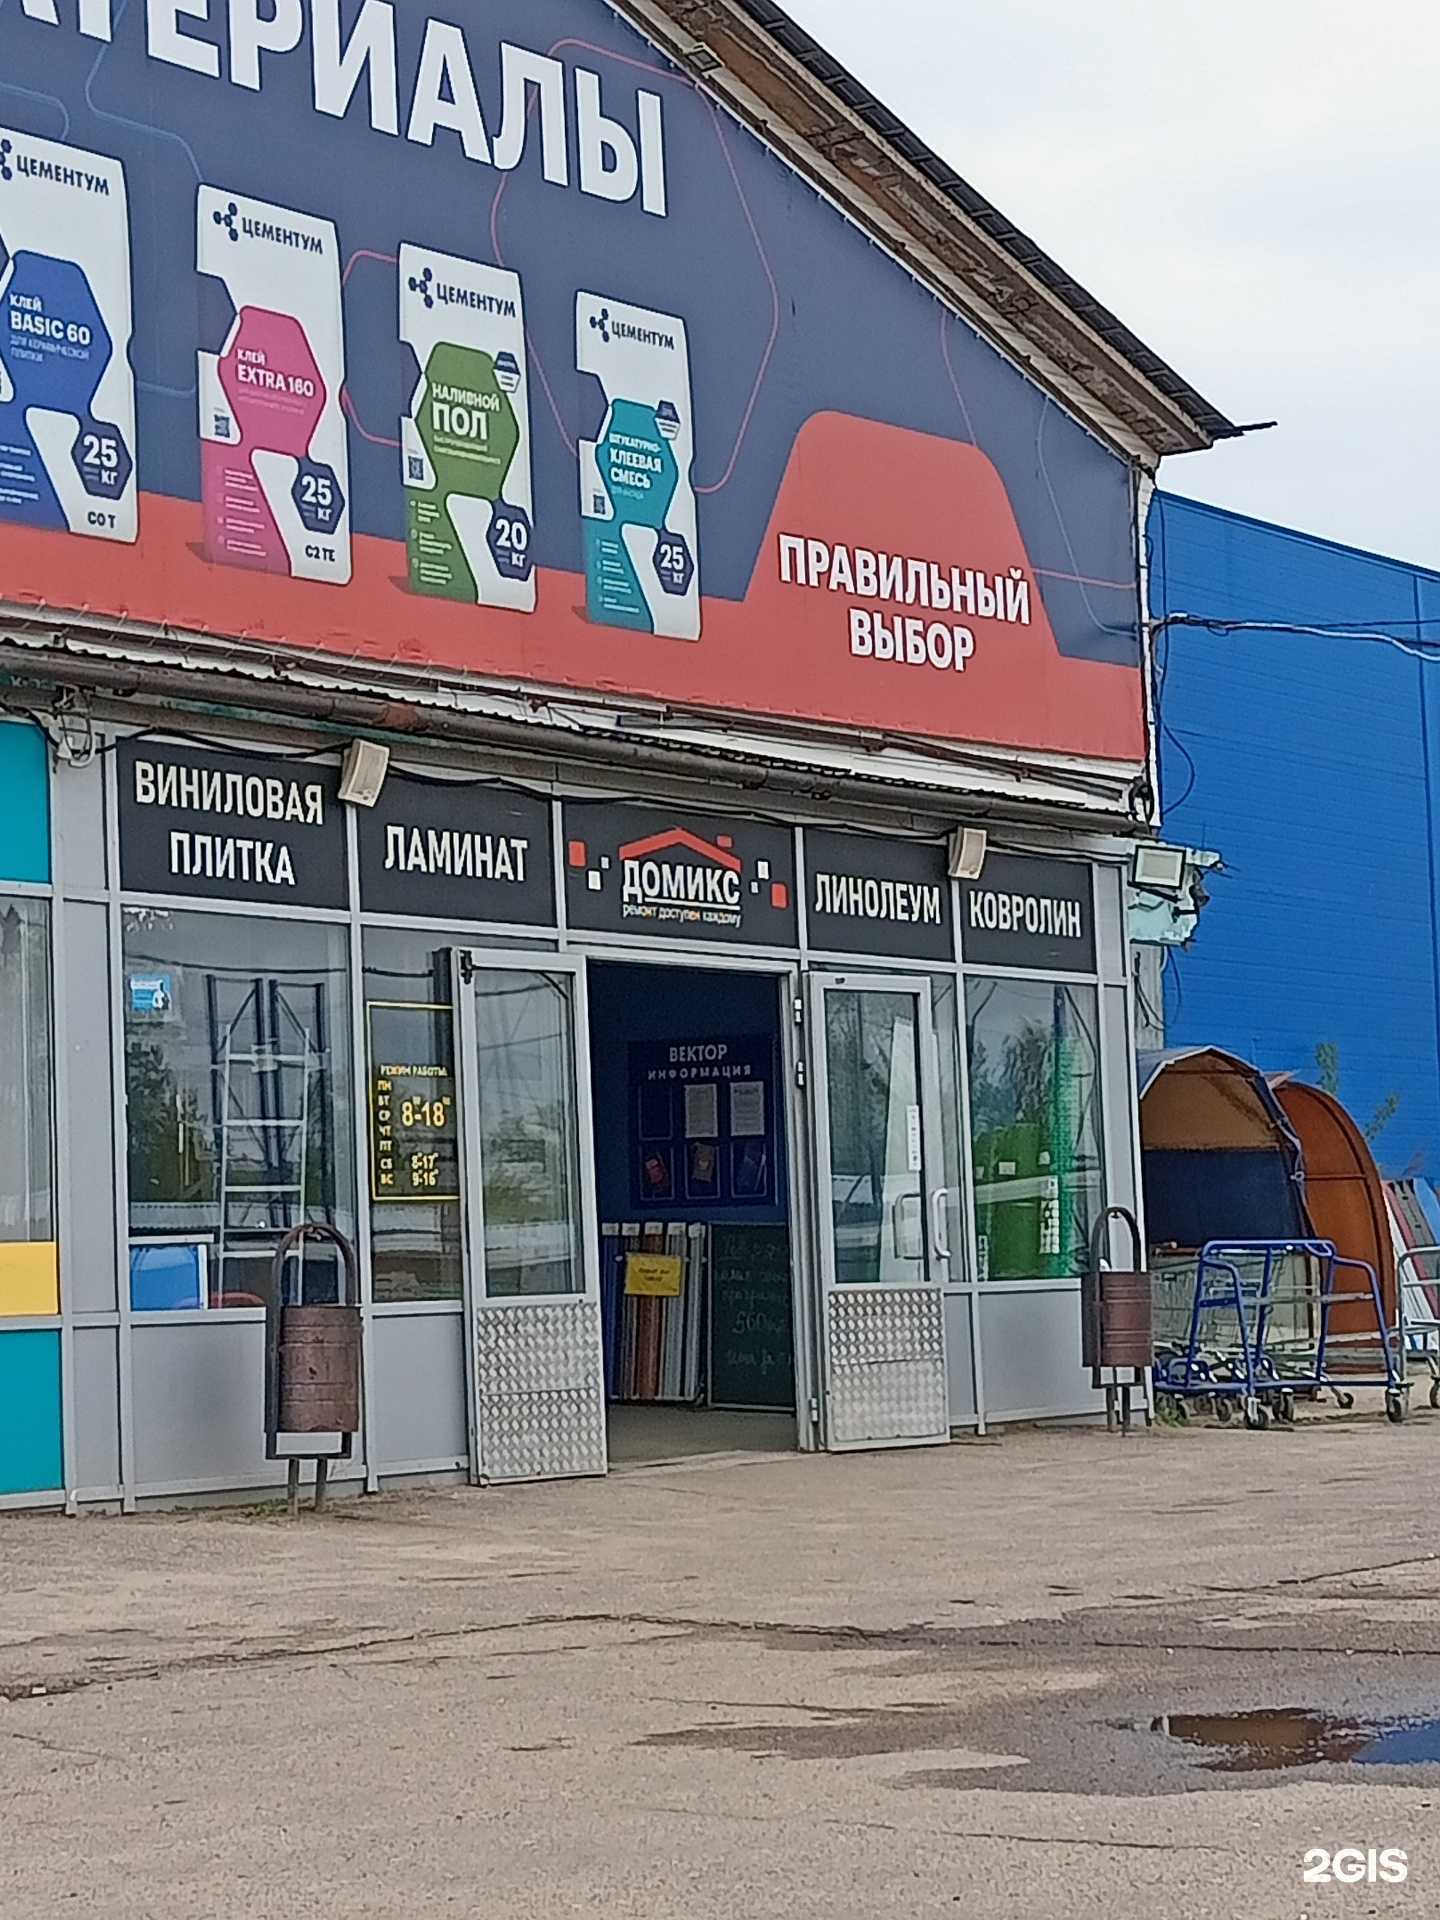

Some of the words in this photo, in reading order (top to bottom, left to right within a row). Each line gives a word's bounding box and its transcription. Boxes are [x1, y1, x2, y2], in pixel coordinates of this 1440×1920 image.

[16, 154, 110, 197] ЦЕМЕНТУМ
[242, 216, 324, 255] ЦЕМЕНТУМ
[9, 293, 43, 313] КЛЕЙ
[436, 282, 517, 319] ЦЕМЕНТУМ
[10, 309, 65, 340] BASIC
[66, 322, 92, 346] 60
[611, 320, 675, 351] ЦЕМЕНТУМ
[236, 348, 266, 366] КЛЕЙ
[237, 364, 287, 392] EXTRA
[287, 376, 315, 398] 160
[431, 381, 500, 413] НАЛИВНОЙ
[432, 400, 488, 441] ПОЛ
[82, 433, 119, 469] 25
[609, 447, 663, 474] КЛЕЕВАЯ
[301, 474, 333, 507] 25
[610, 466, 652, 490] СМЕСЬ
[495, 518, 528, 552] 20
[660, 543, 685, 571] 25
[778, 532, 1031, 625] ПРАВИЛЬНЫЙ
[849, 607, 975, 673] ВЫБОР
[134, 759, 324, 826] ВИНИЛОВАЯ
[168, 831, 296, 886] ПЛИТКА
[384, 824, 529, 882] ЛАМИНАТ
[622, 859, 741, 905] ДОМИКС
[815, 872, 942, 925] ЛИНОЛЕУМ
[968, 889, 1082, 939] КОВРОЛИН
[669, 1044, 728, 1063] ВЕКТОР
[647, 1064, 752, 1081] ИНФОРМАЦИЯ
